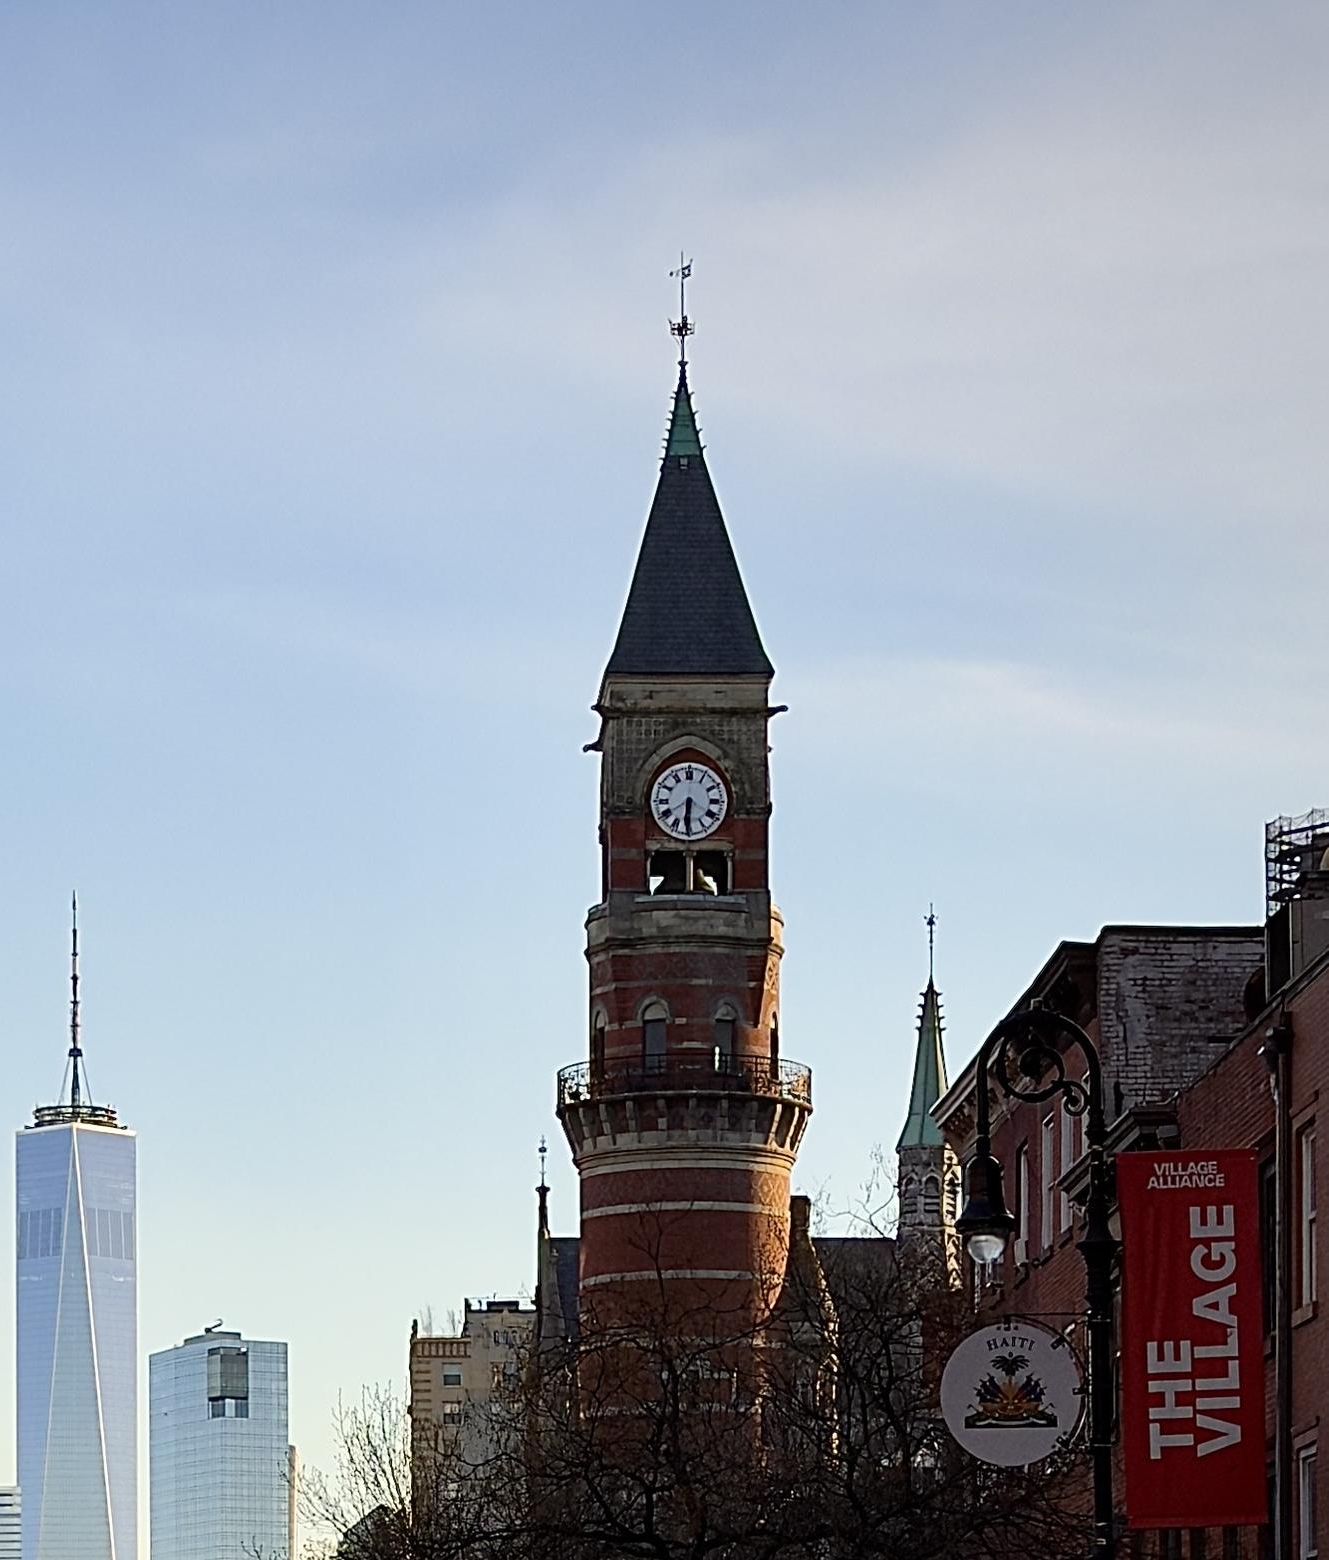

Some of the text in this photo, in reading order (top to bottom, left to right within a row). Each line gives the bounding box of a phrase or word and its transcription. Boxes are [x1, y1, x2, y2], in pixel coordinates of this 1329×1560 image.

[1153, 1161, 1218, 1176] VILLAGE
[1147, 1173, 1225, 1190] ALLIANCE
[1189, 1204, 1242, 1458] VILLAGE
[986, 1336, 1035, 1351] HAITI
[1146, 1339, 1195, 1460] THE
